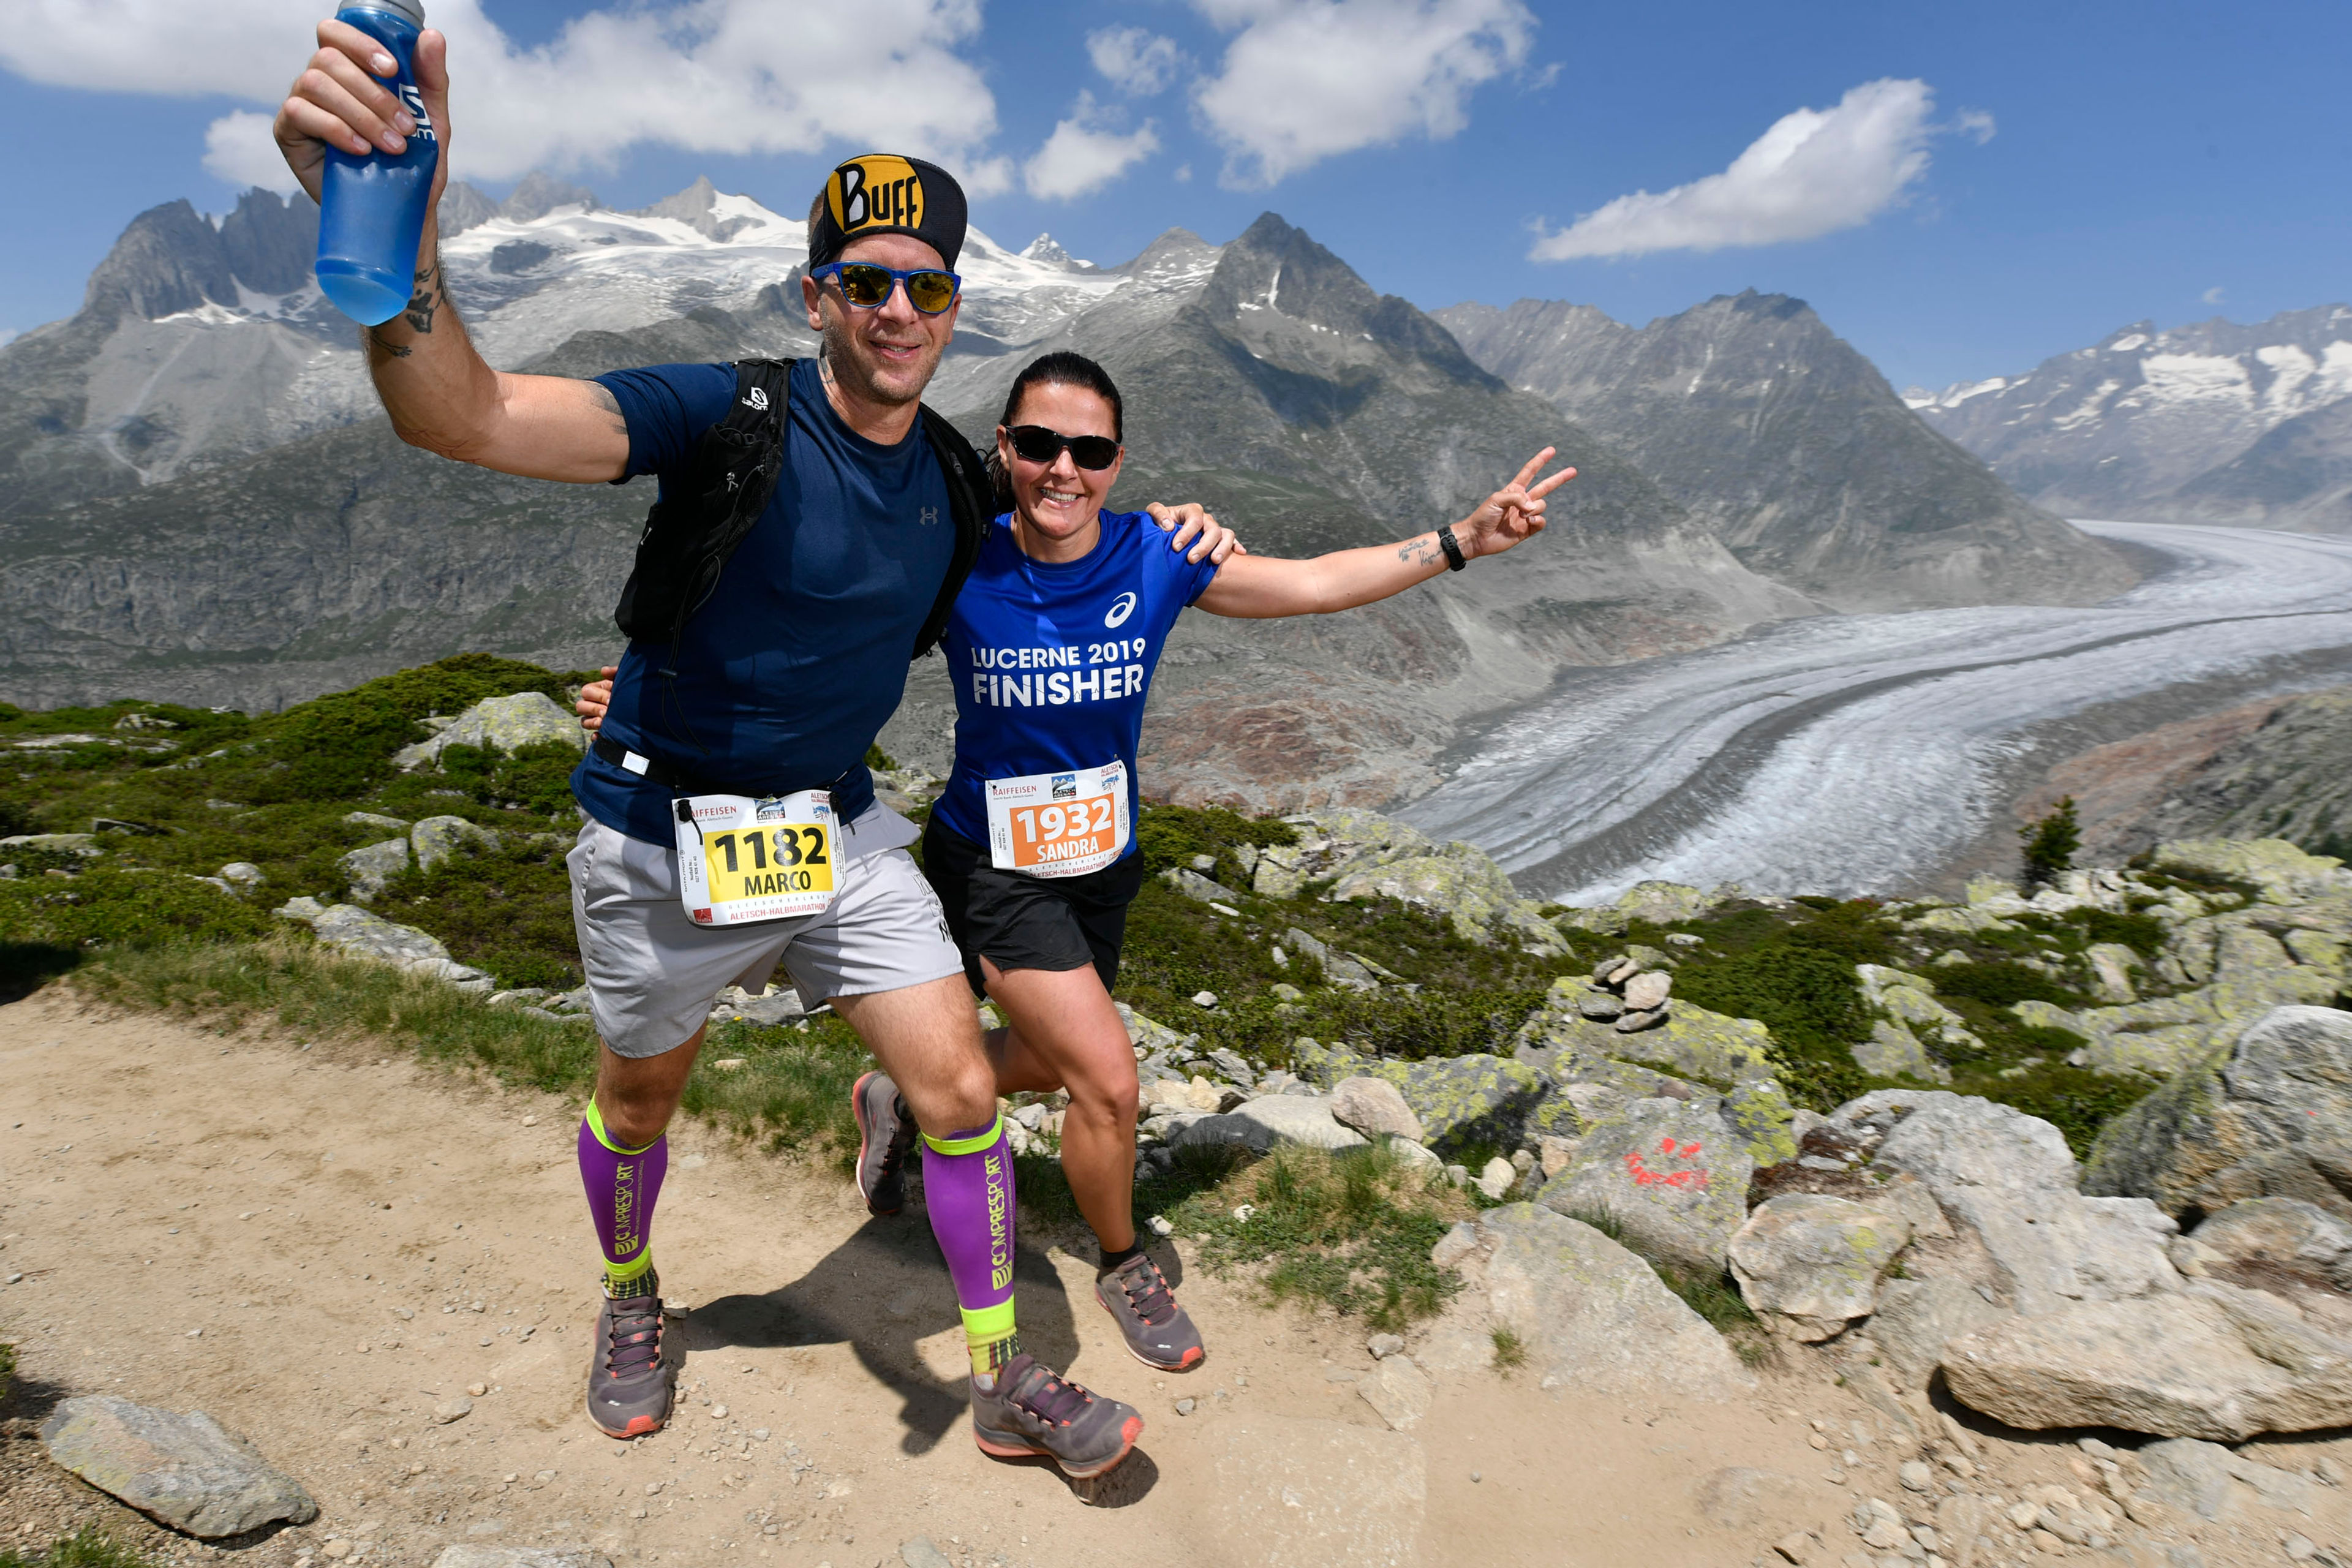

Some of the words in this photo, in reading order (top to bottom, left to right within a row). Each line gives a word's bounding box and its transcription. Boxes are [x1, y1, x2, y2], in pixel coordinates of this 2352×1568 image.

[971, 646, 1080, 668] LUCERNE
[1088, 638, 1146, 664] 2019
[973, 664, 1144, 707] FINISHER
[993, 785, 1037, 796] RAIFFEISEN
[691, 805, 737, 818] AIFFEISEN
[1017, 798, 1112, 843] 1932
[714, 827, 827, 872] 1182
[1036, 836, 1099, 862] SANDRA
[1030, 861, 1106, 878] ALETSCH-HALBMARATHON
[745, 870, 811, 896] MARCO
[731, 902, 826, 921] ALETSCH-HALBMARATHON
